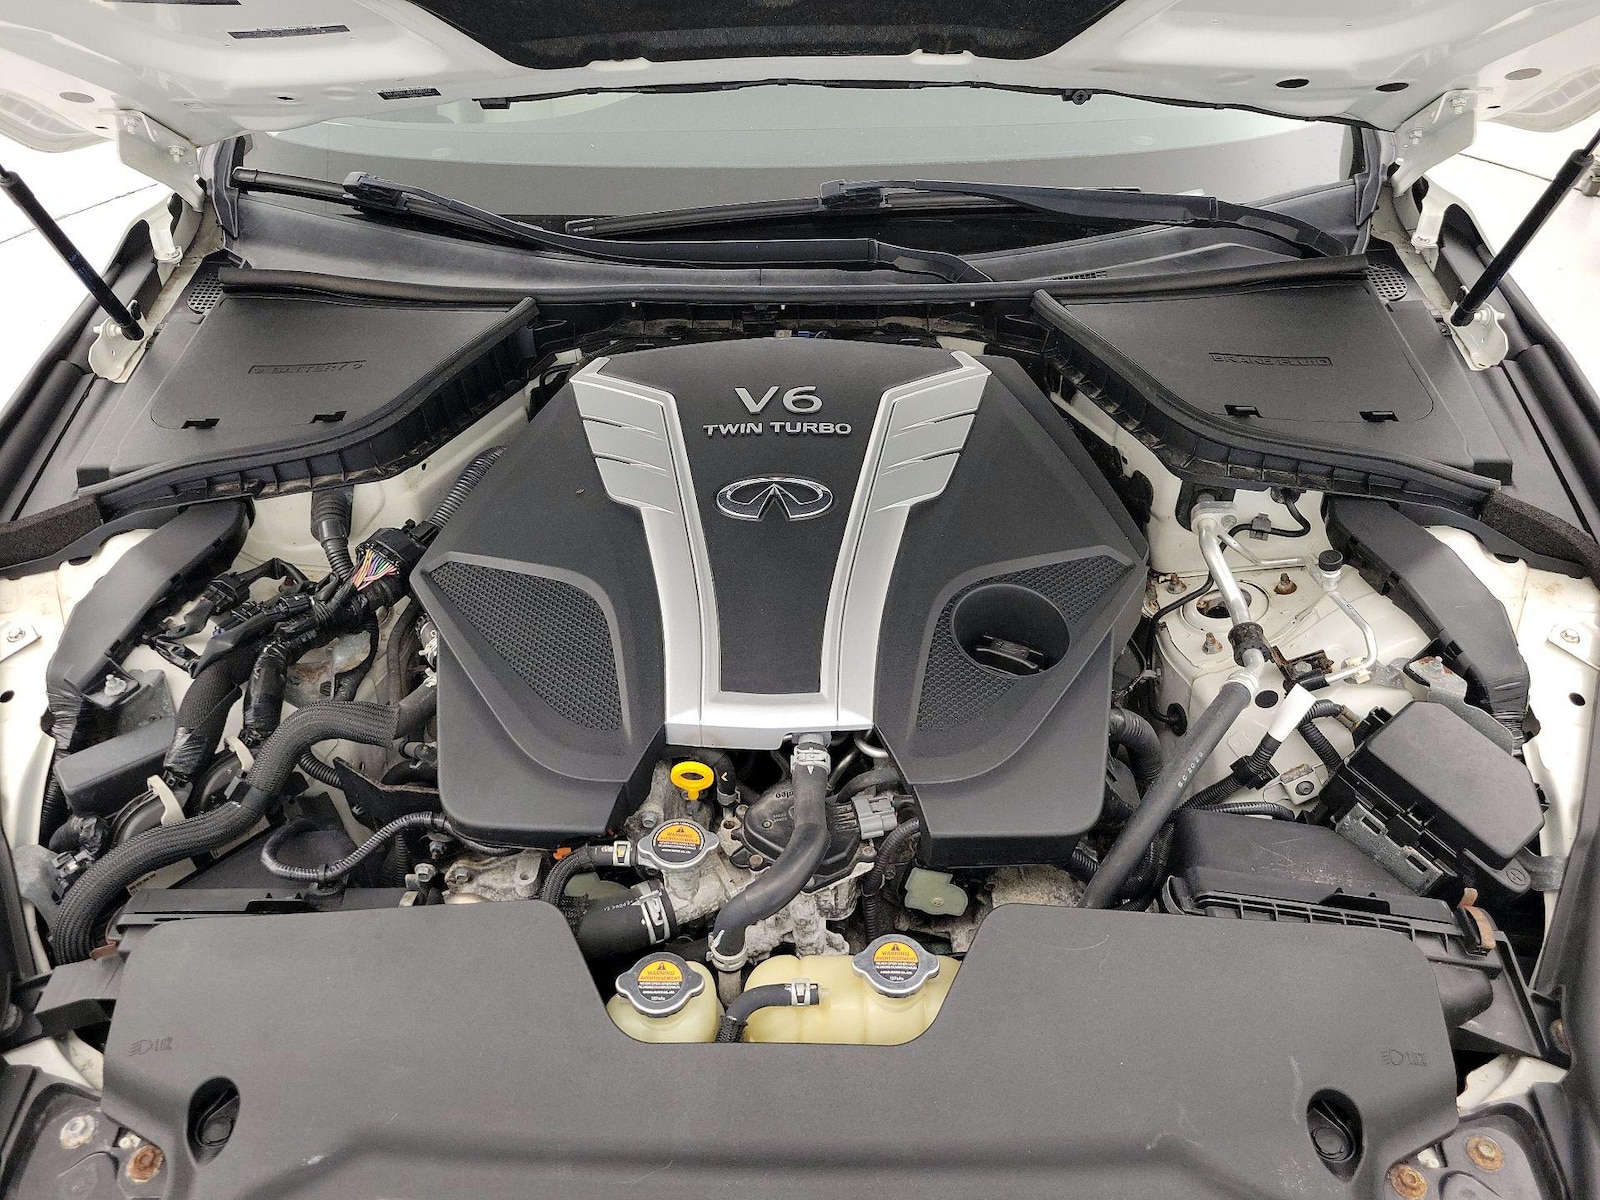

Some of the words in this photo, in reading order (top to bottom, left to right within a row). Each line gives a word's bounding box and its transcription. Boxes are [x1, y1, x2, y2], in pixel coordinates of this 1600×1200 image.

[1211, 354, 1274, 366] BRAKE
[1277, 358, 1330, 366] FLUID
[271, 364, 348, 375] BATTERY
[734, 385, 824, 415] V6
[702, 422, 764, 437] TWIN
[769, 420, 852, 436] TURBO
[775, 790, 795, 799] aleo
